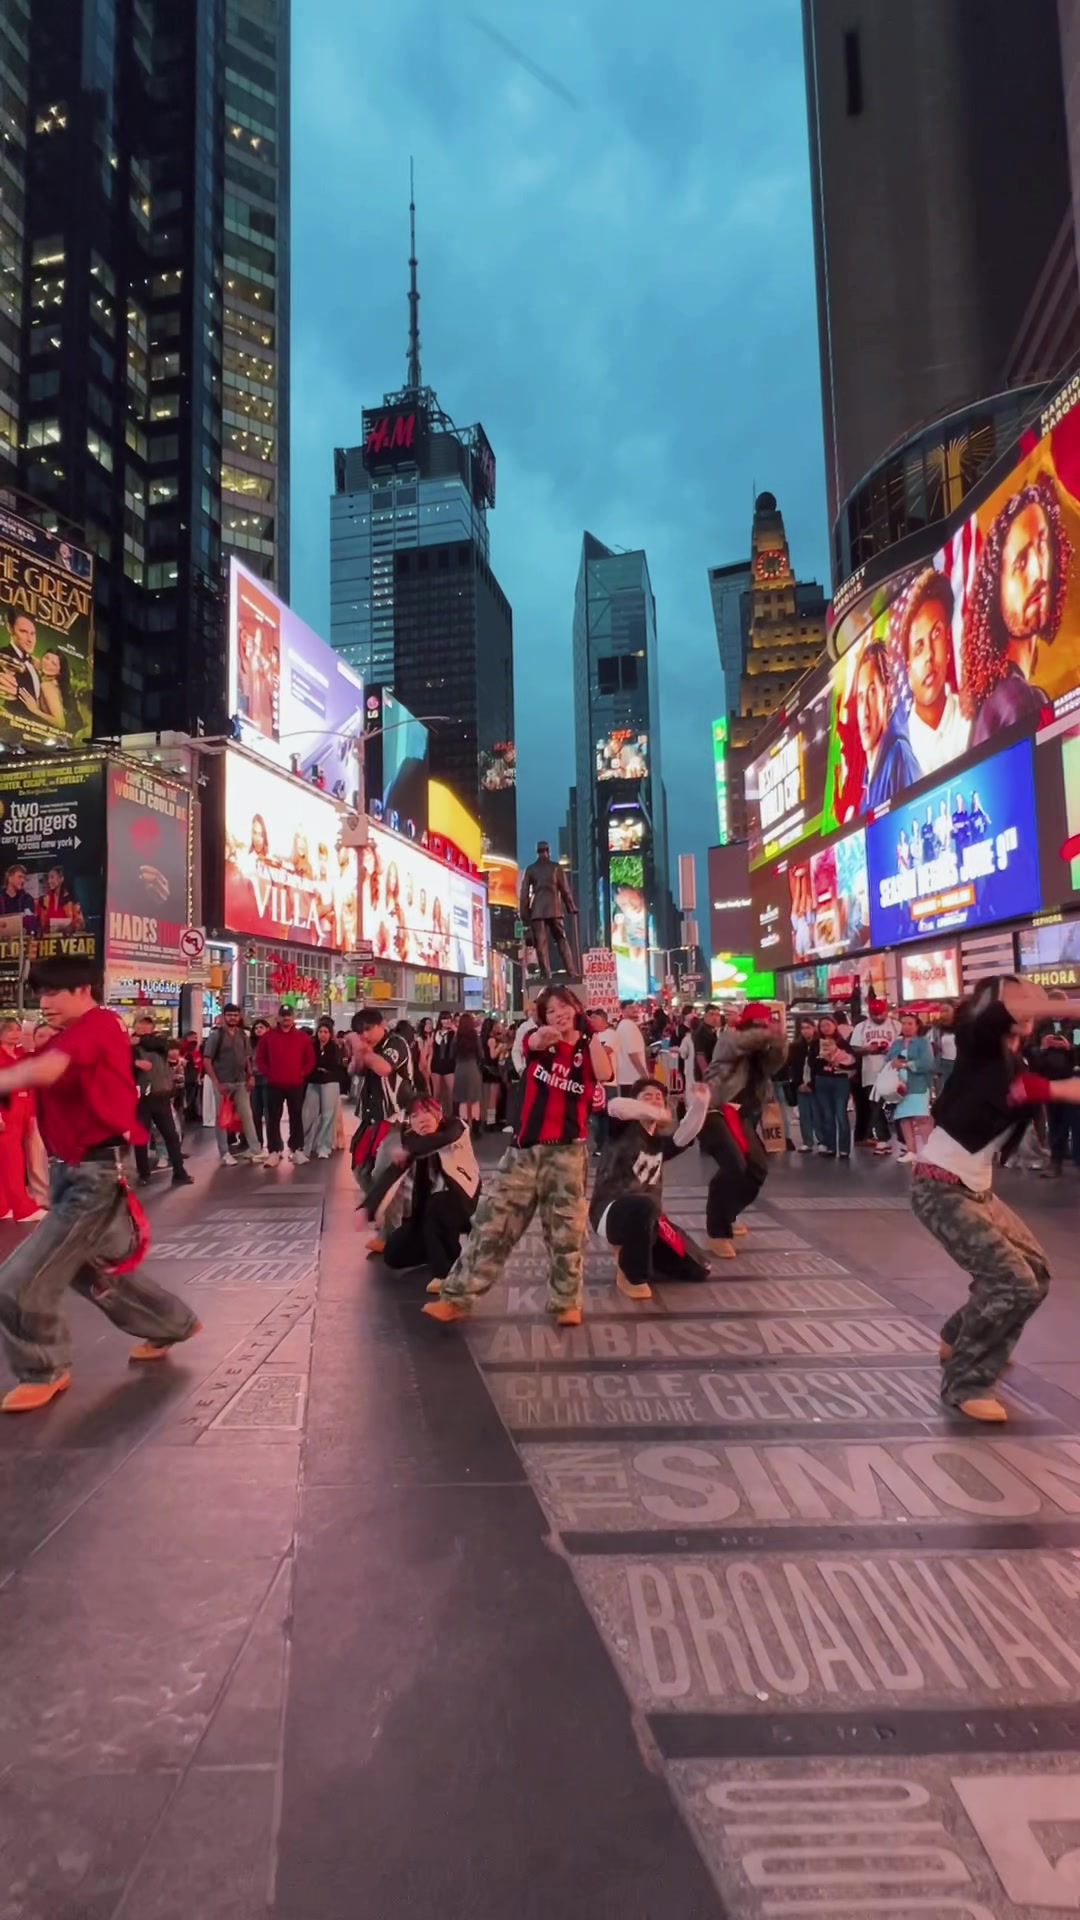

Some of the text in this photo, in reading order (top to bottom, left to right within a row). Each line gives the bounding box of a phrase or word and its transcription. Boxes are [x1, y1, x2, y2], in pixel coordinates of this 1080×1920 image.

[24, 567, 92, 616] GREAT
[367, 710, 379, 719] LG
[114, 779, 146, 805] WORLD
[147, 794, 175, 817] COULD
[10, 801, 39, 819] two
[3, 813, 77, 836] strangers
[41, 839, 56, 849] new
[57, 836, 73, 849] york
[1032, 914, 1063, 927] SEPHORA
[60, 938, 95, 955] YEAR
[586, 961, 615, 973] JESUS
[587, 954, 612, 962] ONLY
[141, 978, 181, 993] LUGGAGE
[1027, 969, 1076, 986] EPHORA
[533, 1064, 585, 1094] Emirates
[150, 1239, 318, 1259] PALACE
[489, 1319, 941, 1360] AMBASSADOR
[506, 1374, 692, 1399] CIRCLE
[700, 1371, 943, 1421] GERSHW
[517, 1398, 701, 1424] IN THE SQUARE
[633, 1441, 1080, 1522] SIMON
[627, 1557, 1080, 1698] BROADWAY
